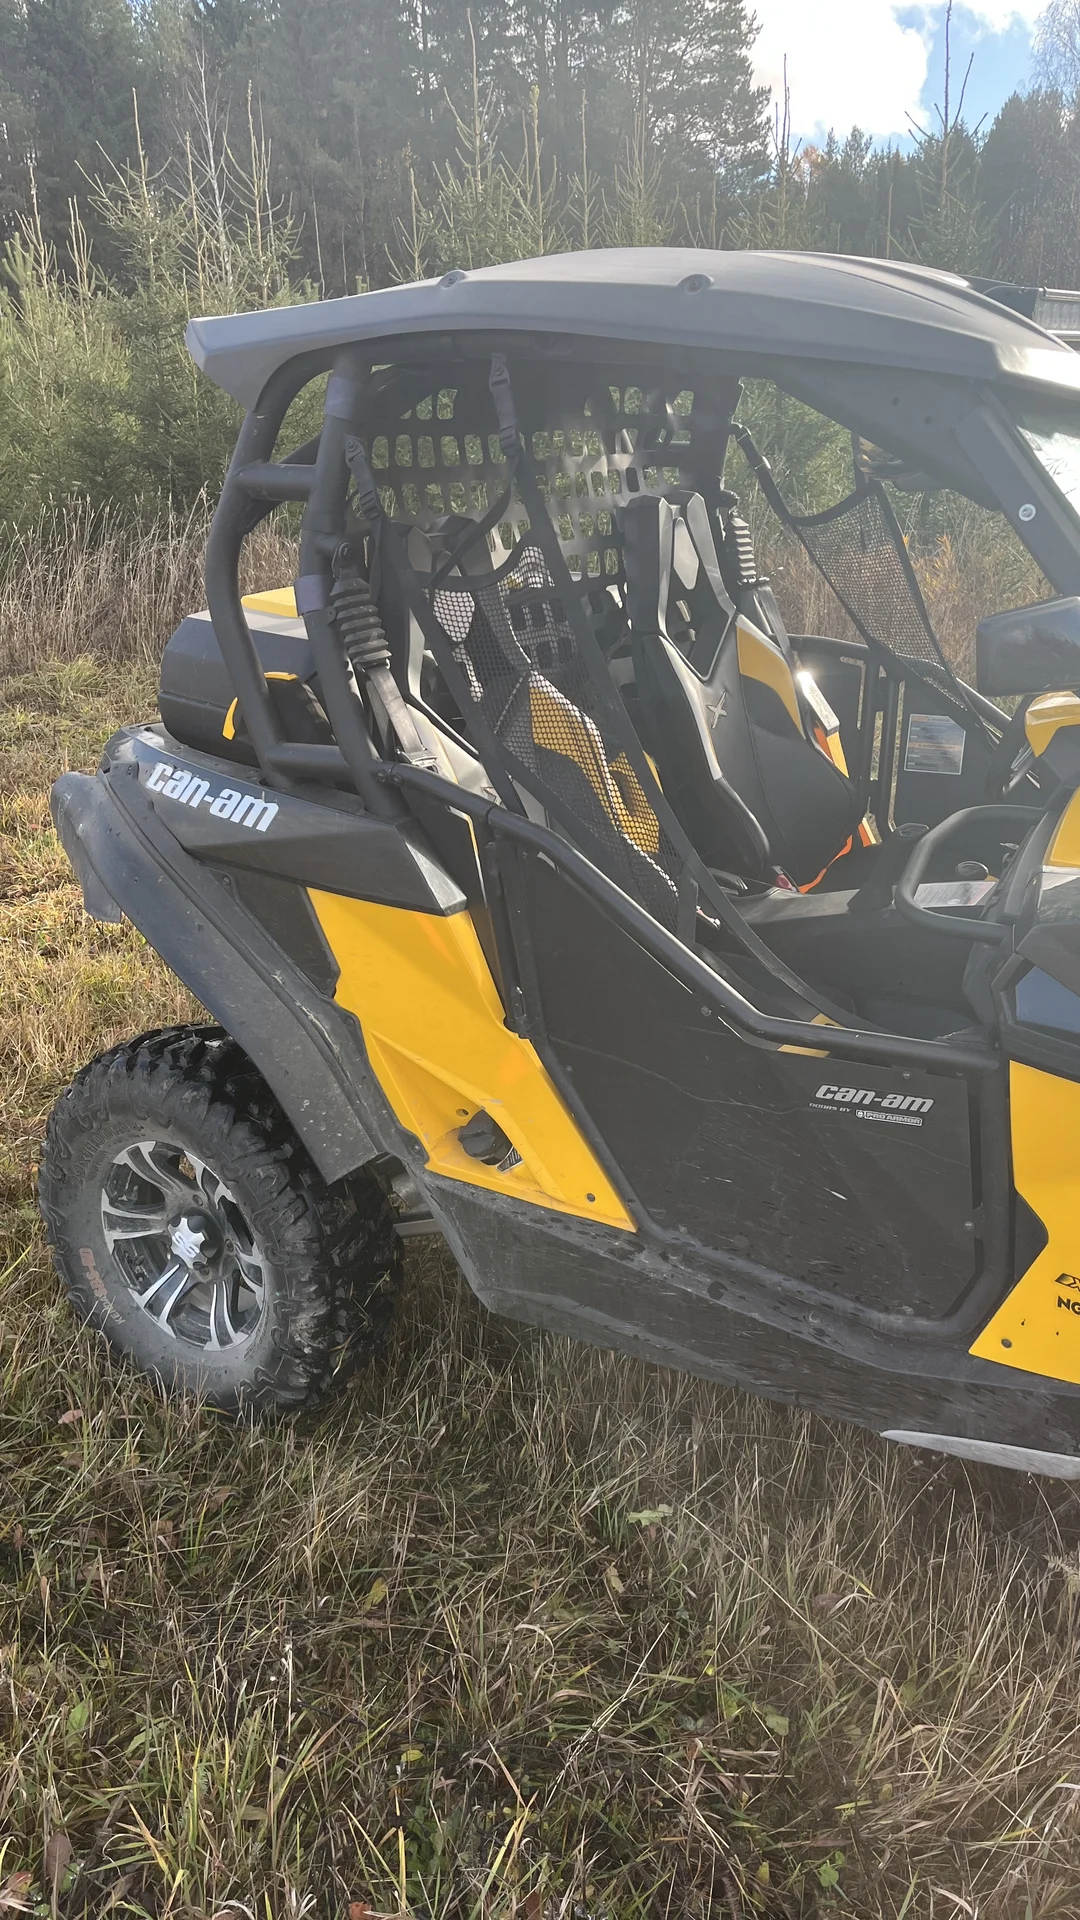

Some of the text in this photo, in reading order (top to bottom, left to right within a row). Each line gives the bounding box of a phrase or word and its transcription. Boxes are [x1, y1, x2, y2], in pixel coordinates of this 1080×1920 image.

[146, 762, 279, 832] can-am
[809, 1102, 838, 1111] DOORS
[815, 1084, 934, 1112] can-am
